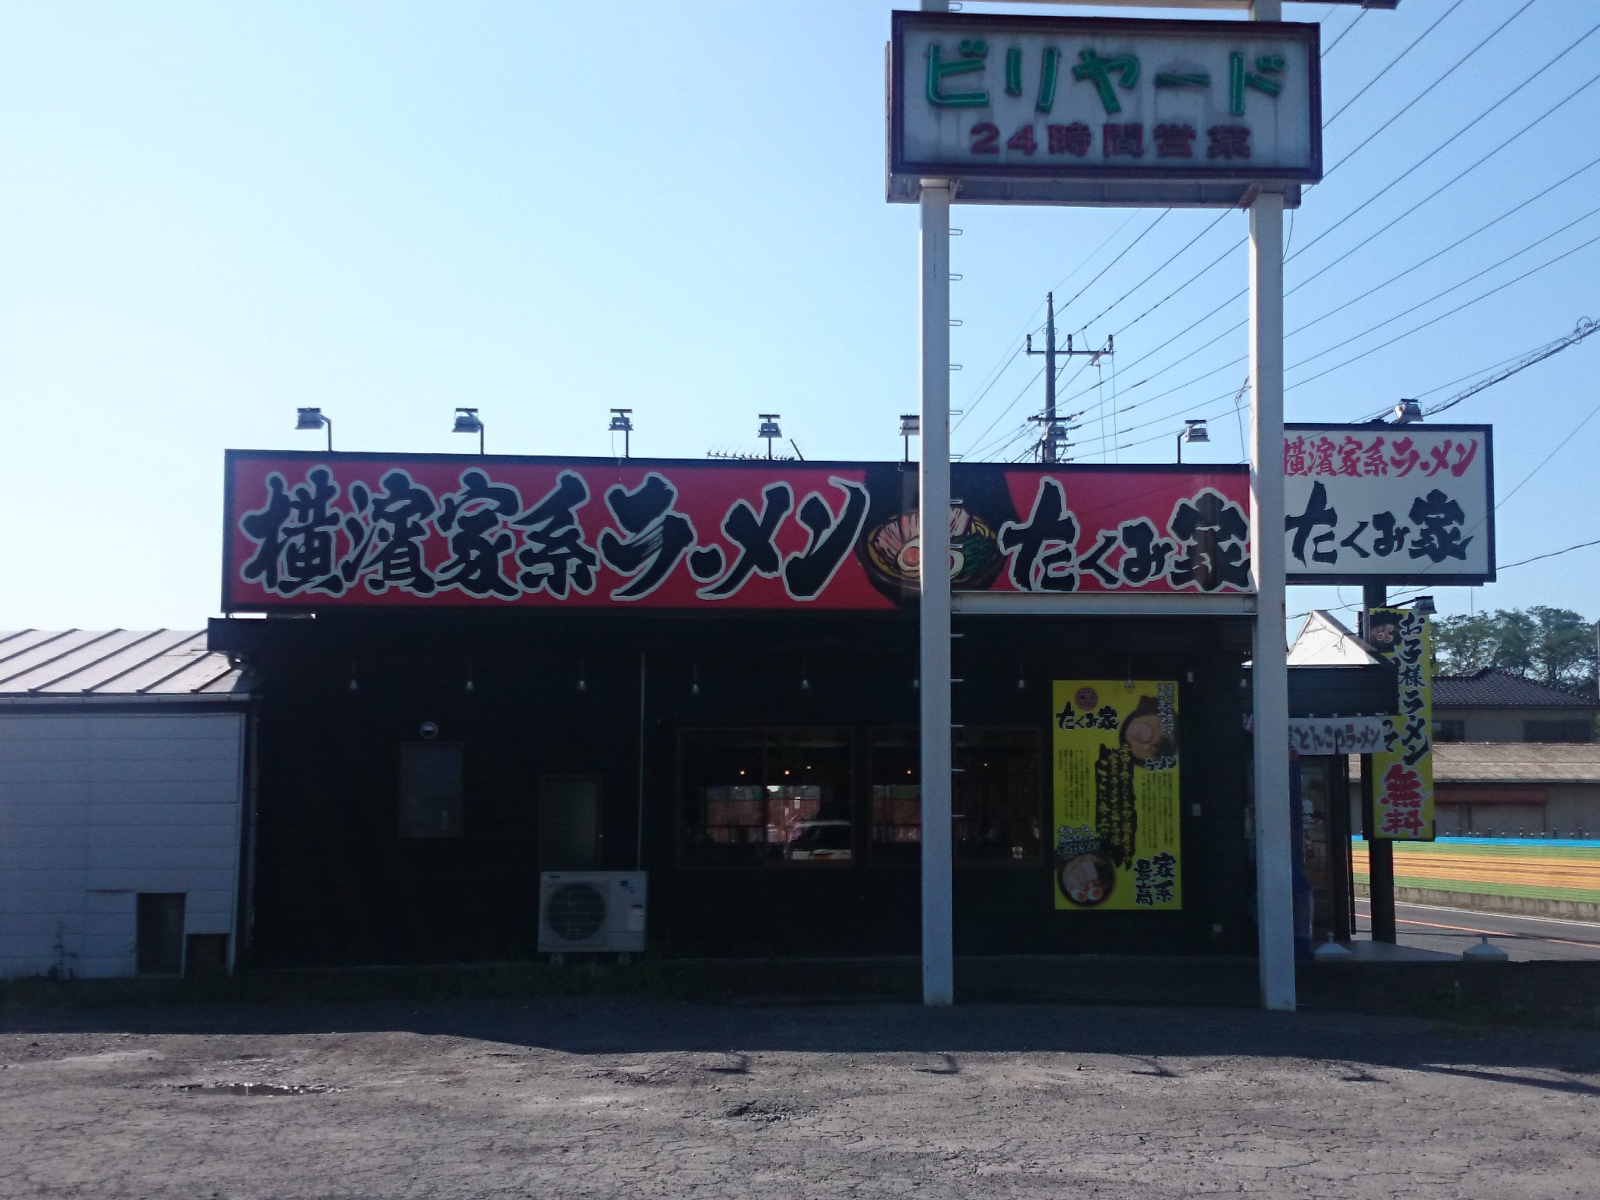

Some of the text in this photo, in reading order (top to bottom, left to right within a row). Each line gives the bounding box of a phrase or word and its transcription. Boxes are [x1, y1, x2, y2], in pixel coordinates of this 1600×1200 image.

[924, 38, 1286, 116] ビリヤード
[970, 122, 1251, 159] 24時間営業
[998, 476, 1252, 591] たくみ家
[1284, 480, 1474, 568] たくみ家
[1056, 701, 1119, 731] たくみ家
[1288, 723, 1381, 751] とんこつラーメン
[1380, 763, 1426, 836] 無料
[1133, 858, 1156, 907] 最高
[1152, 851, 1177, 903] 家系
